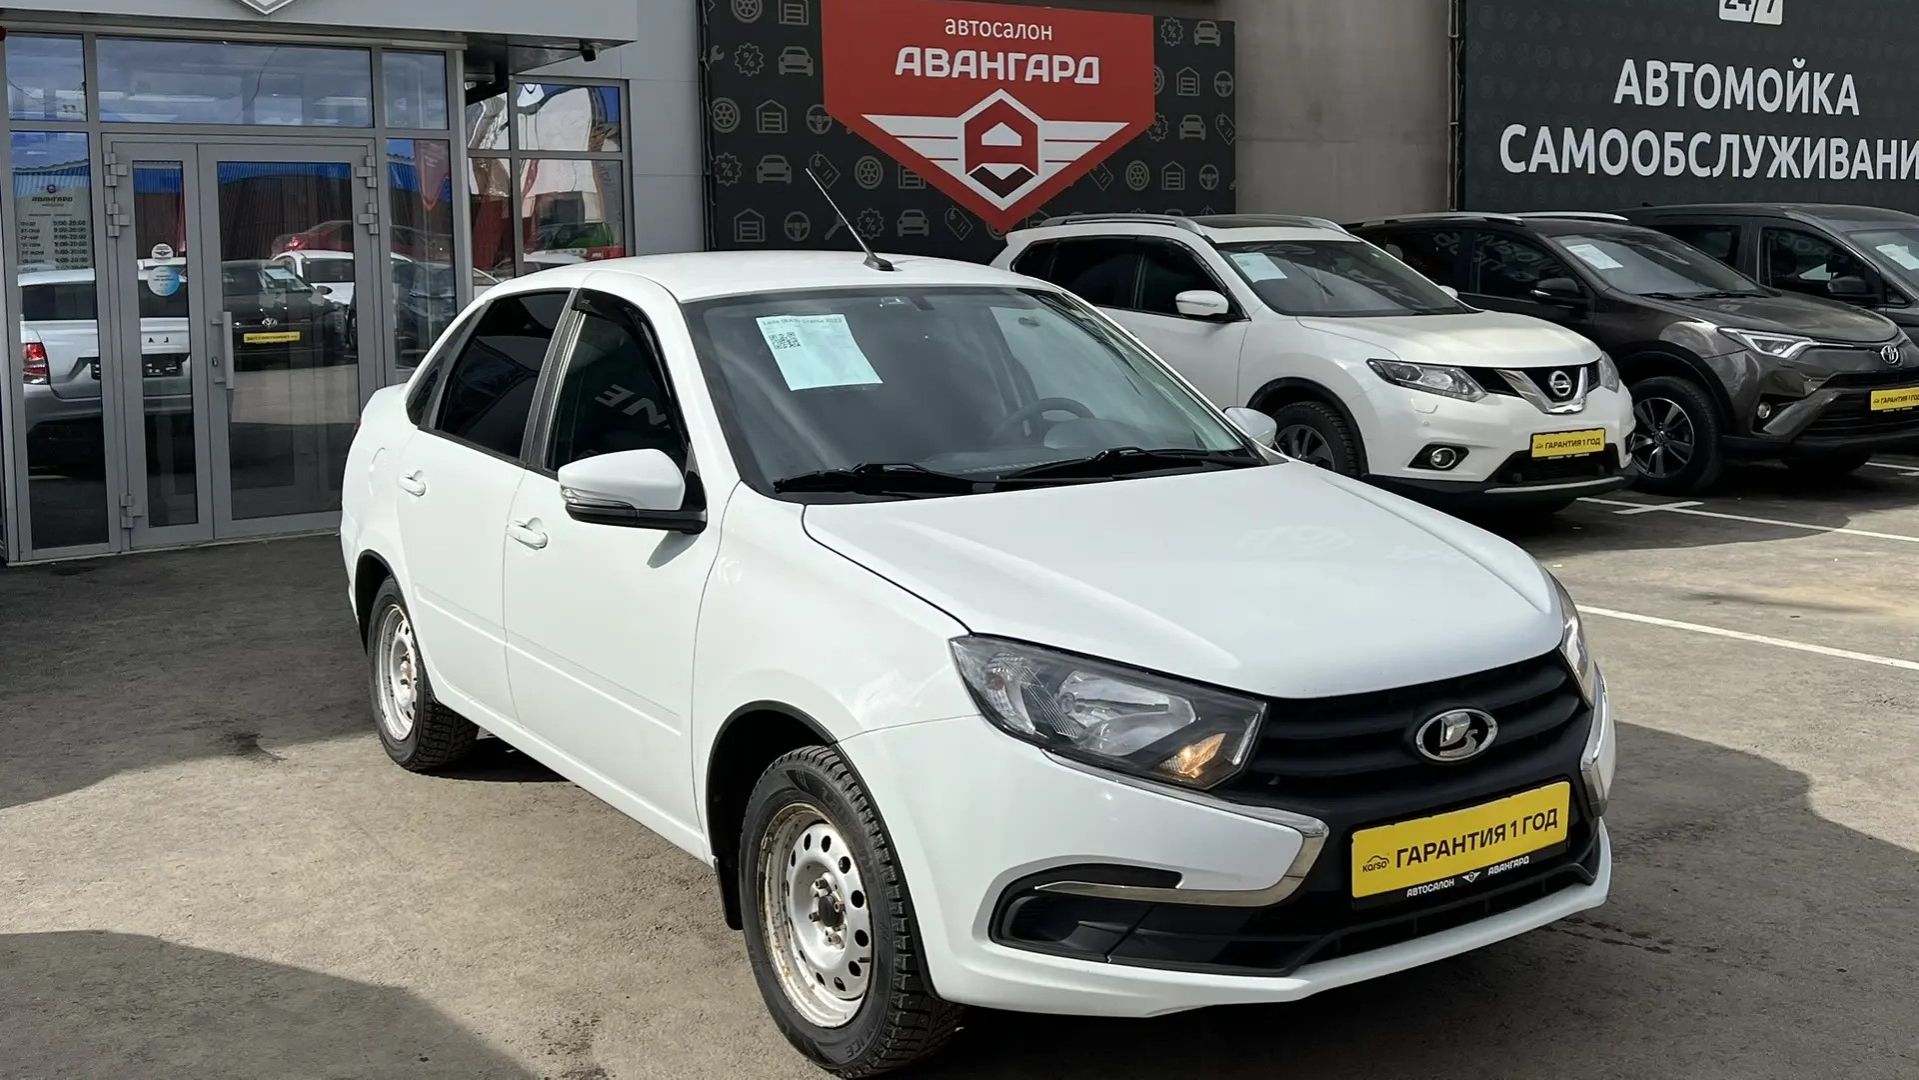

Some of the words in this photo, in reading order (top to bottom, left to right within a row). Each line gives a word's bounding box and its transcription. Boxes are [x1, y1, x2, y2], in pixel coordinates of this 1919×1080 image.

[945, 18, 1053, 41] автосалон
[895, 46, 1100, 85] АВАНГАРД
[1613, 57, 1860, 116] АВТОМОЙКА
[1500, 124, 1919, 181] САМООБСЛУЖИВАНИ
[1544, 439, 1582, 450] ГАРАНТИЯ
[1586, 437, 1601, 446] ГОД
[1396, 823, 1507, 869] ГАРАНТИЯ
[1510, 820, 1518, 838] 1
[1522, 808, 1558, 834] ГОД
[1406, 877, 1455, 898] АВТОСАЛОН
[1487, 855, 1530, 876] АВАНГАРД
